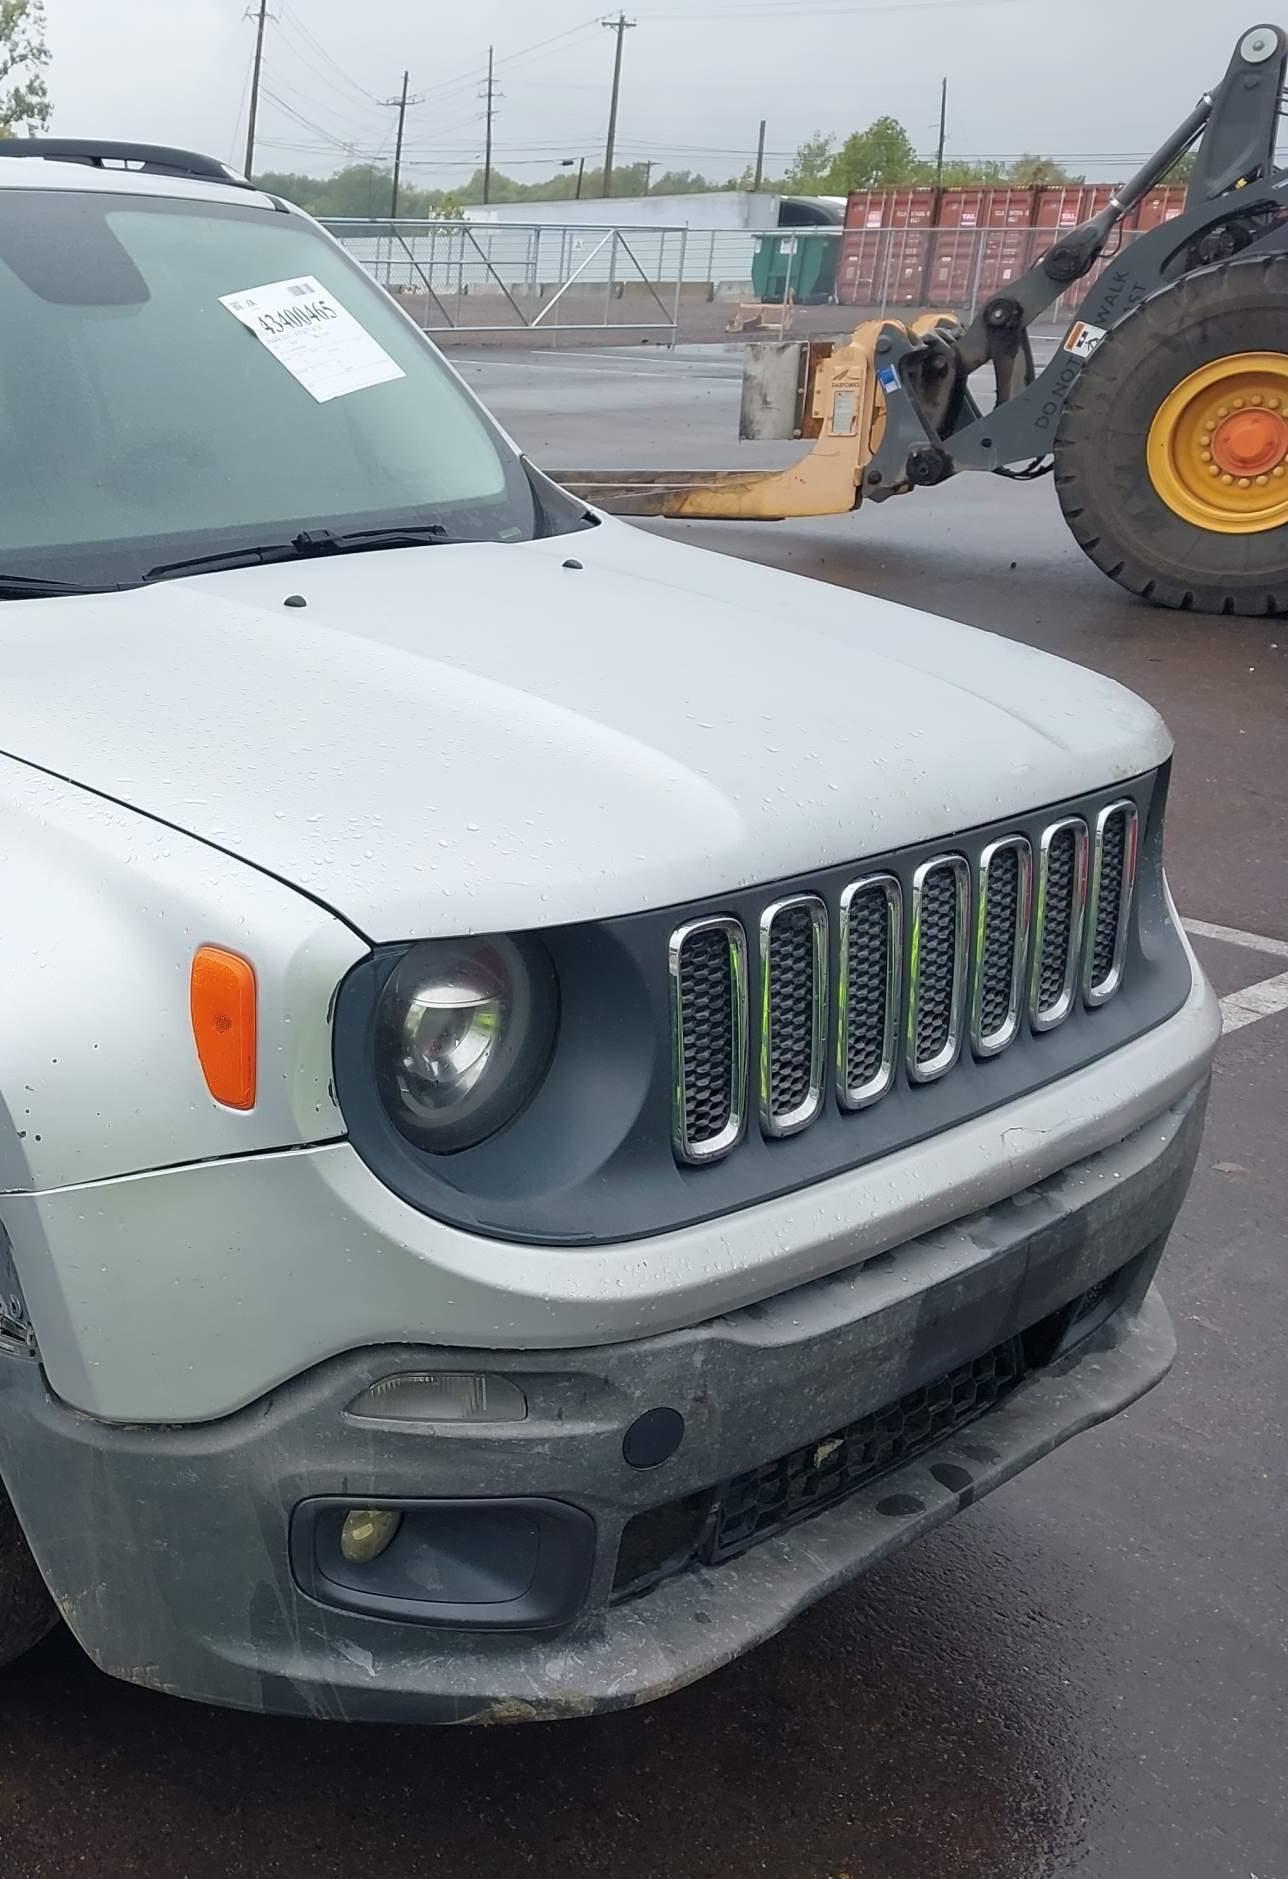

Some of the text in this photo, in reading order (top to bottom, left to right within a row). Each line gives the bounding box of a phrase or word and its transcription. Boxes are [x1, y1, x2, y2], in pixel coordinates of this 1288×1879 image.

[258, 300, 338, 335] 43400465
[1034, 401, 1057, 430] DO
[1051, 357, 1081, 397] NOT
[1093, 271, 1130, 324] WALK
